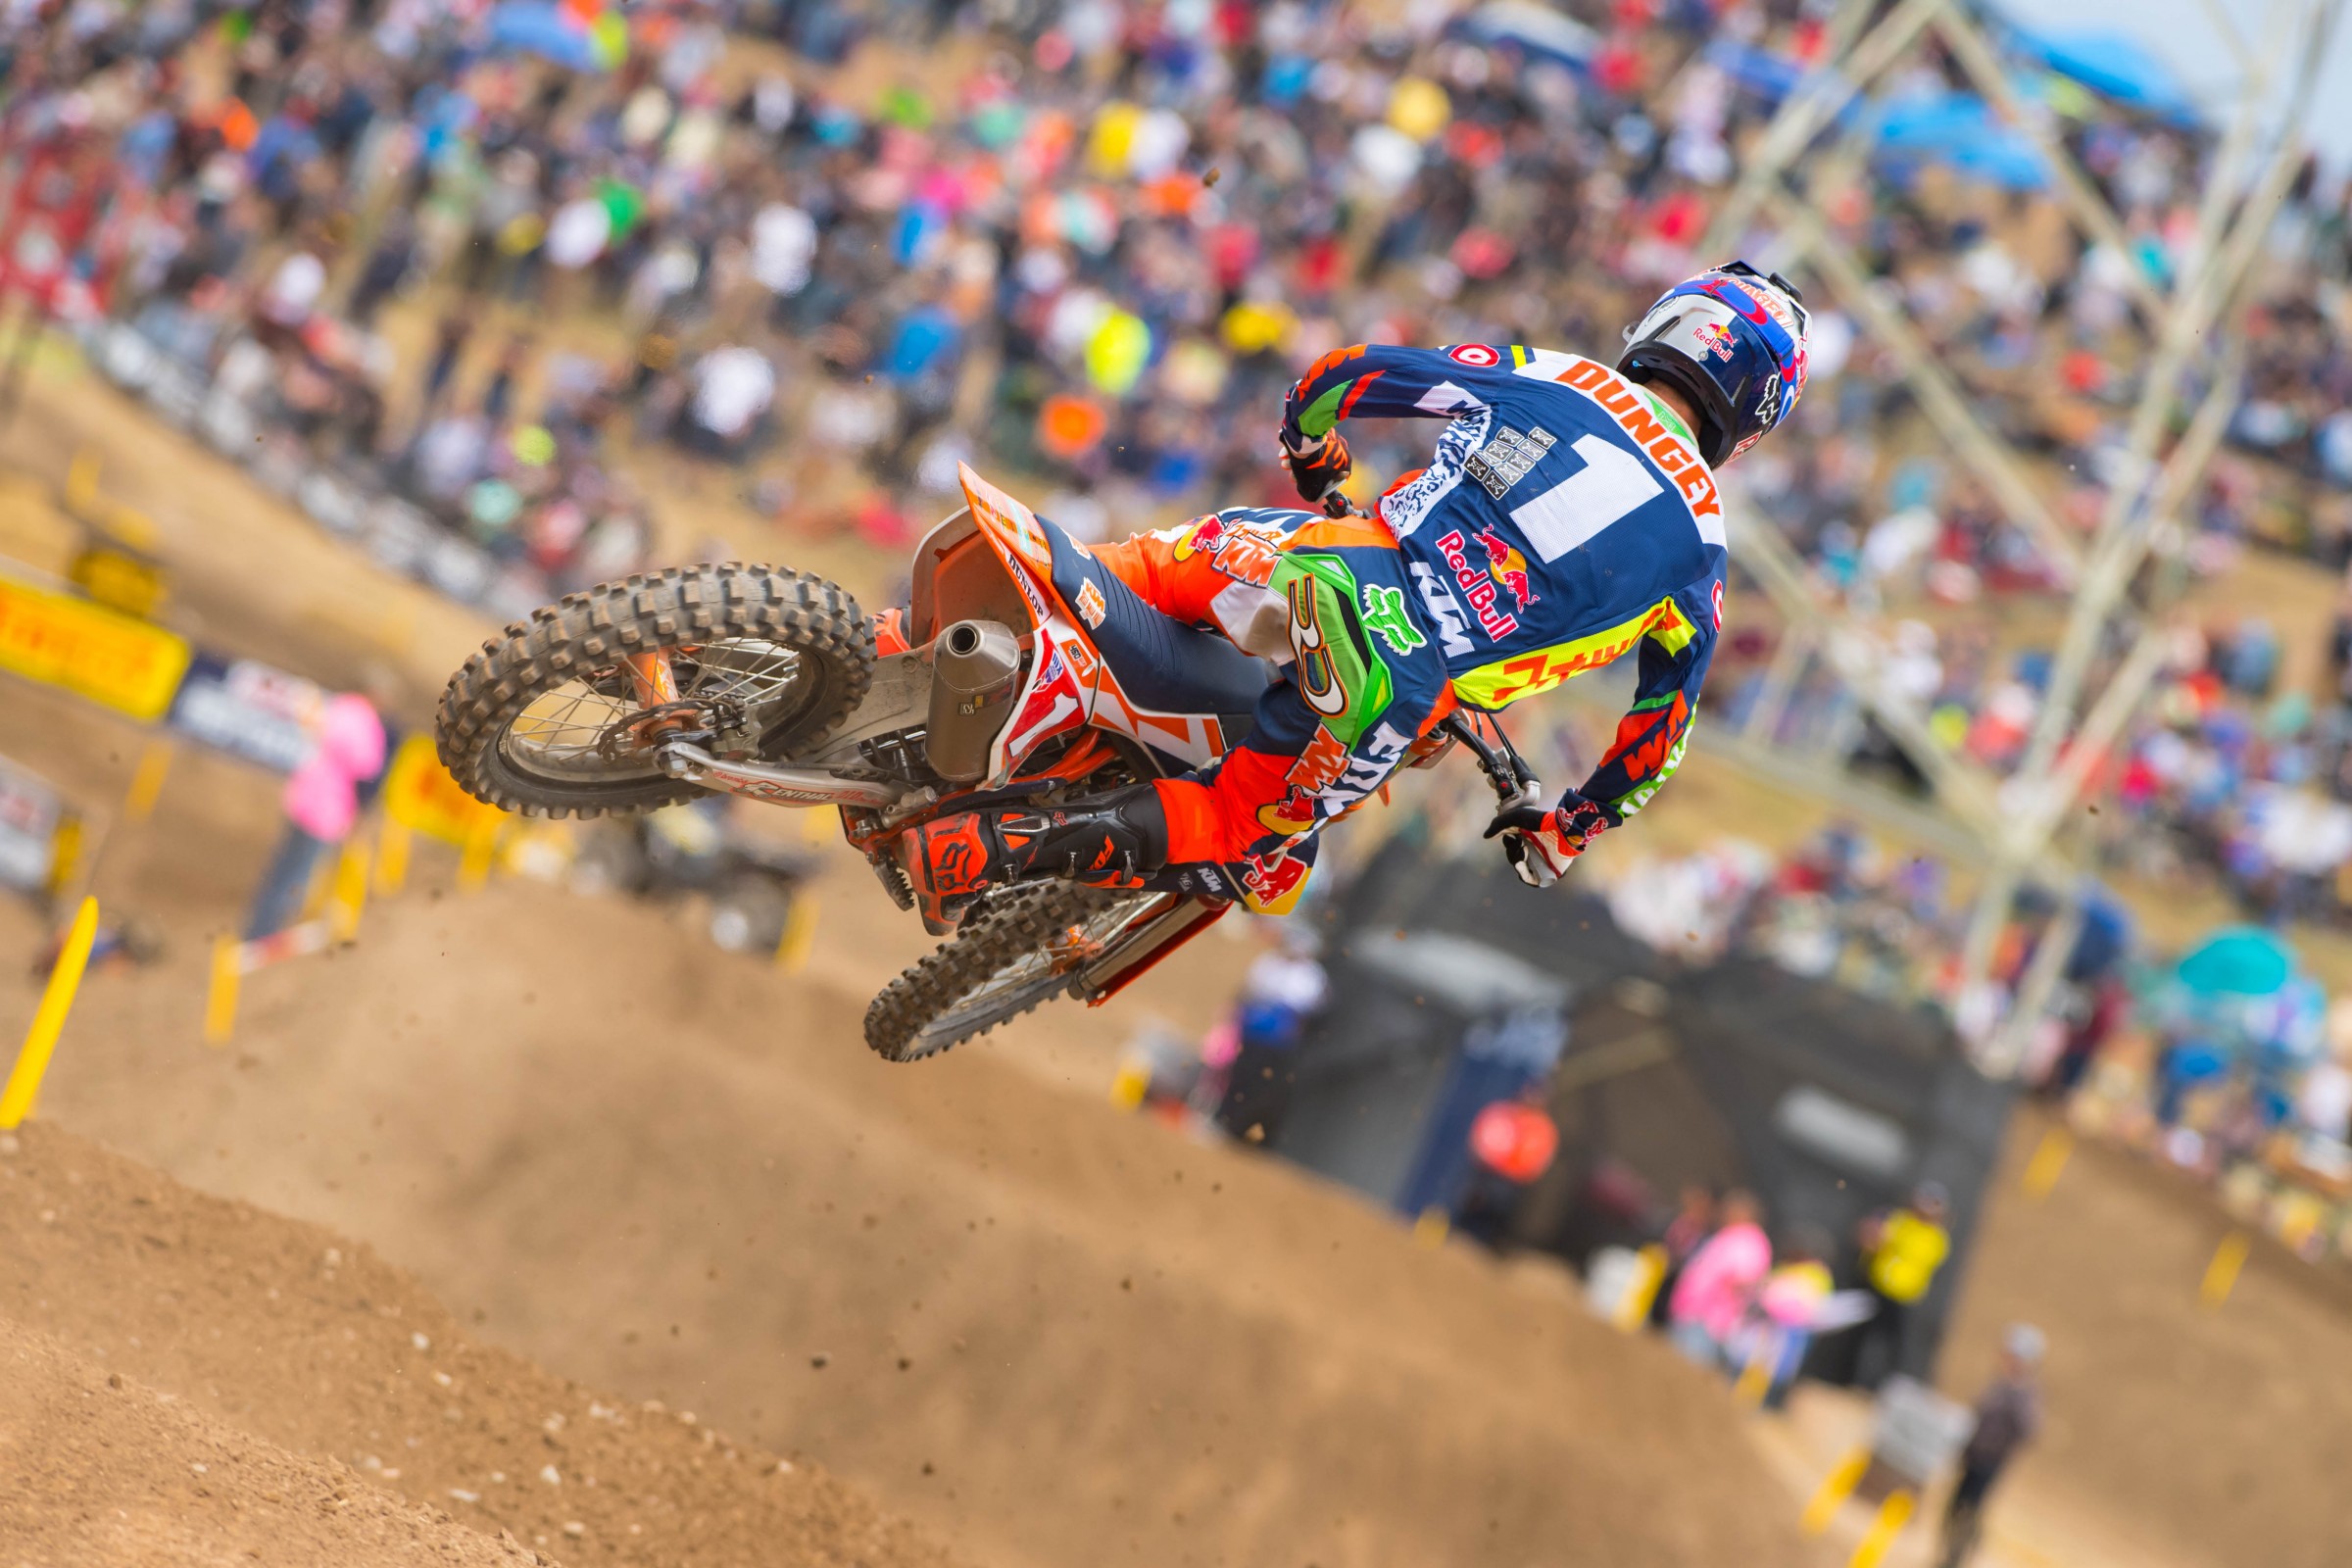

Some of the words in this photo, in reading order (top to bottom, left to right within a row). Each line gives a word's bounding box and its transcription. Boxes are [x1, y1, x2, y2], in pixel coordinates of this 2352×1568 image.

[1693, 326, 1716, 346] Red
[1710, 339, 1734, 363] Bull
[1553, 360, 1721, 518] DUNGEY
[1510, 433, 1665, 564] 1
[1008, 554, 1045, 617] DUNLOP
[1213, 535, 1282, 587] KTM
[1436, 529, 1490, 592] Red
[1465, 580, 1520, 643] Bull
[1409, 561, 1476, 659] KTM
[731, 781, 833, 800] RENTHAL
[1197, 867, 1222, 892] KTM
